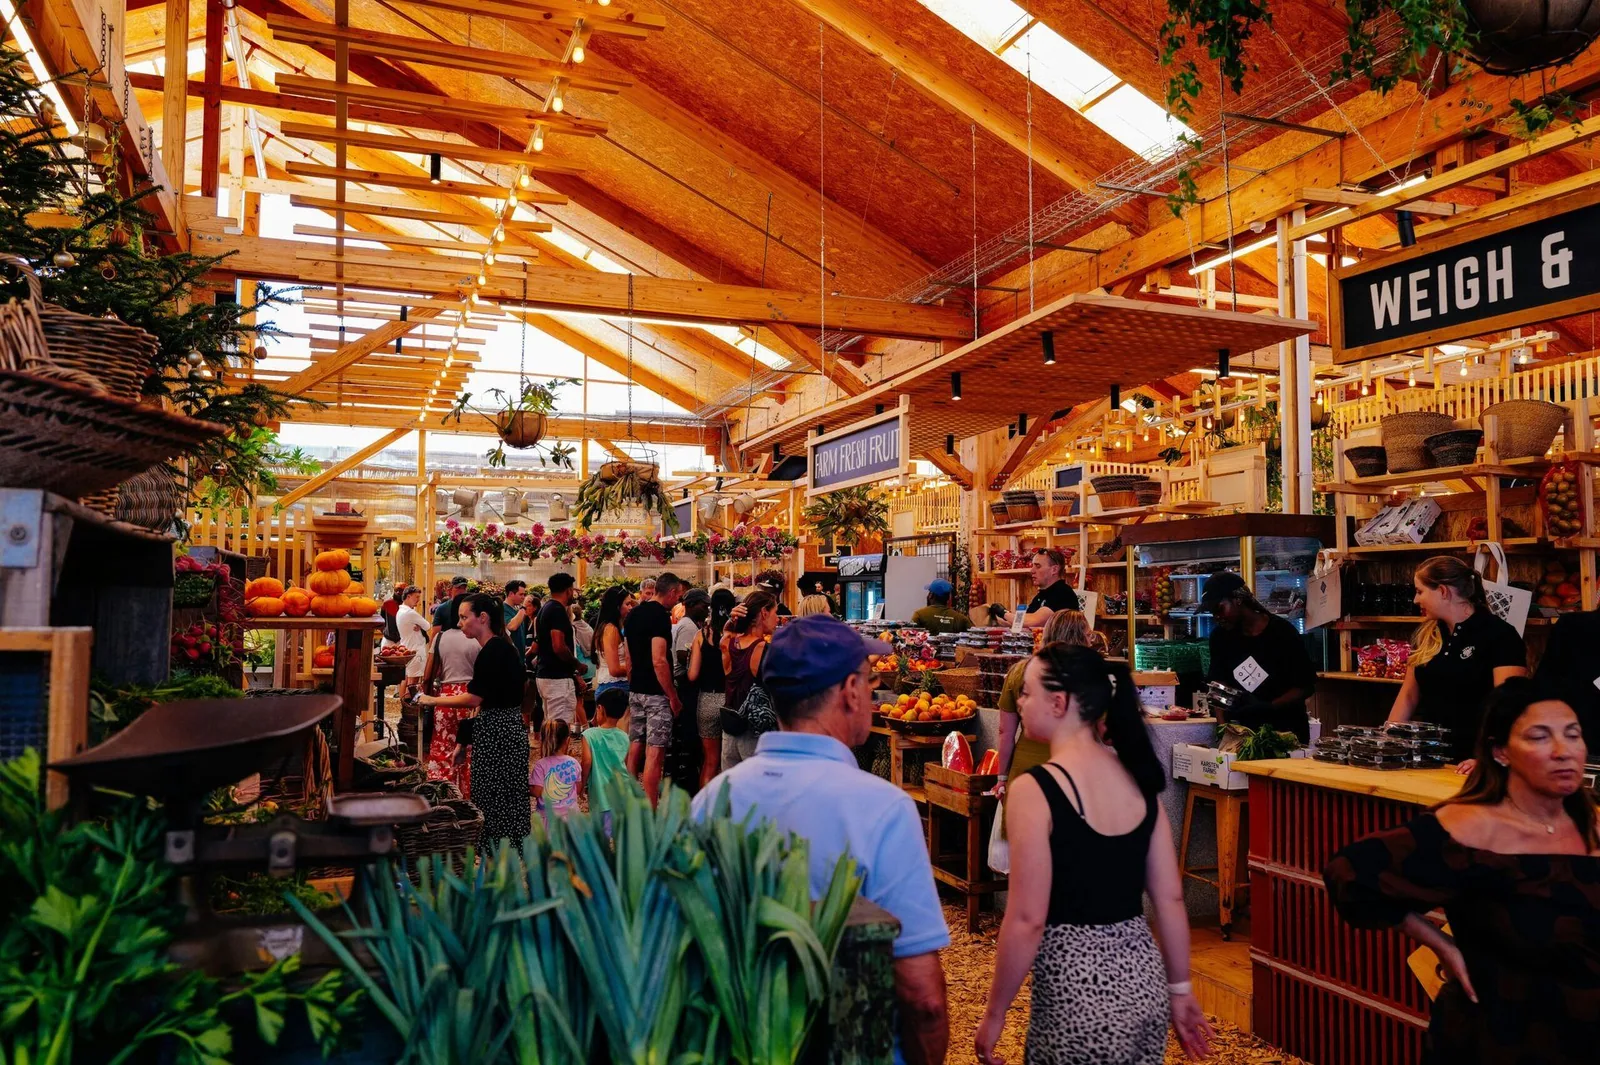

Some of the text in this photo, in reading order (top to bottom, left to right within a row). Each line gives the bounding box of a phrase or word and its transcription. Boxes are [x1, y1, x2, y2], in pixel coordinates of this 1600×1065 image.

[1370, 230, 1574, 330] WEIGH &
[815, 428, 900, 479] FARM FRESH FRUIT
[1200, 760, 1220, 769] KARSTEN
[1202, 766, 1217, 775] FARMS
